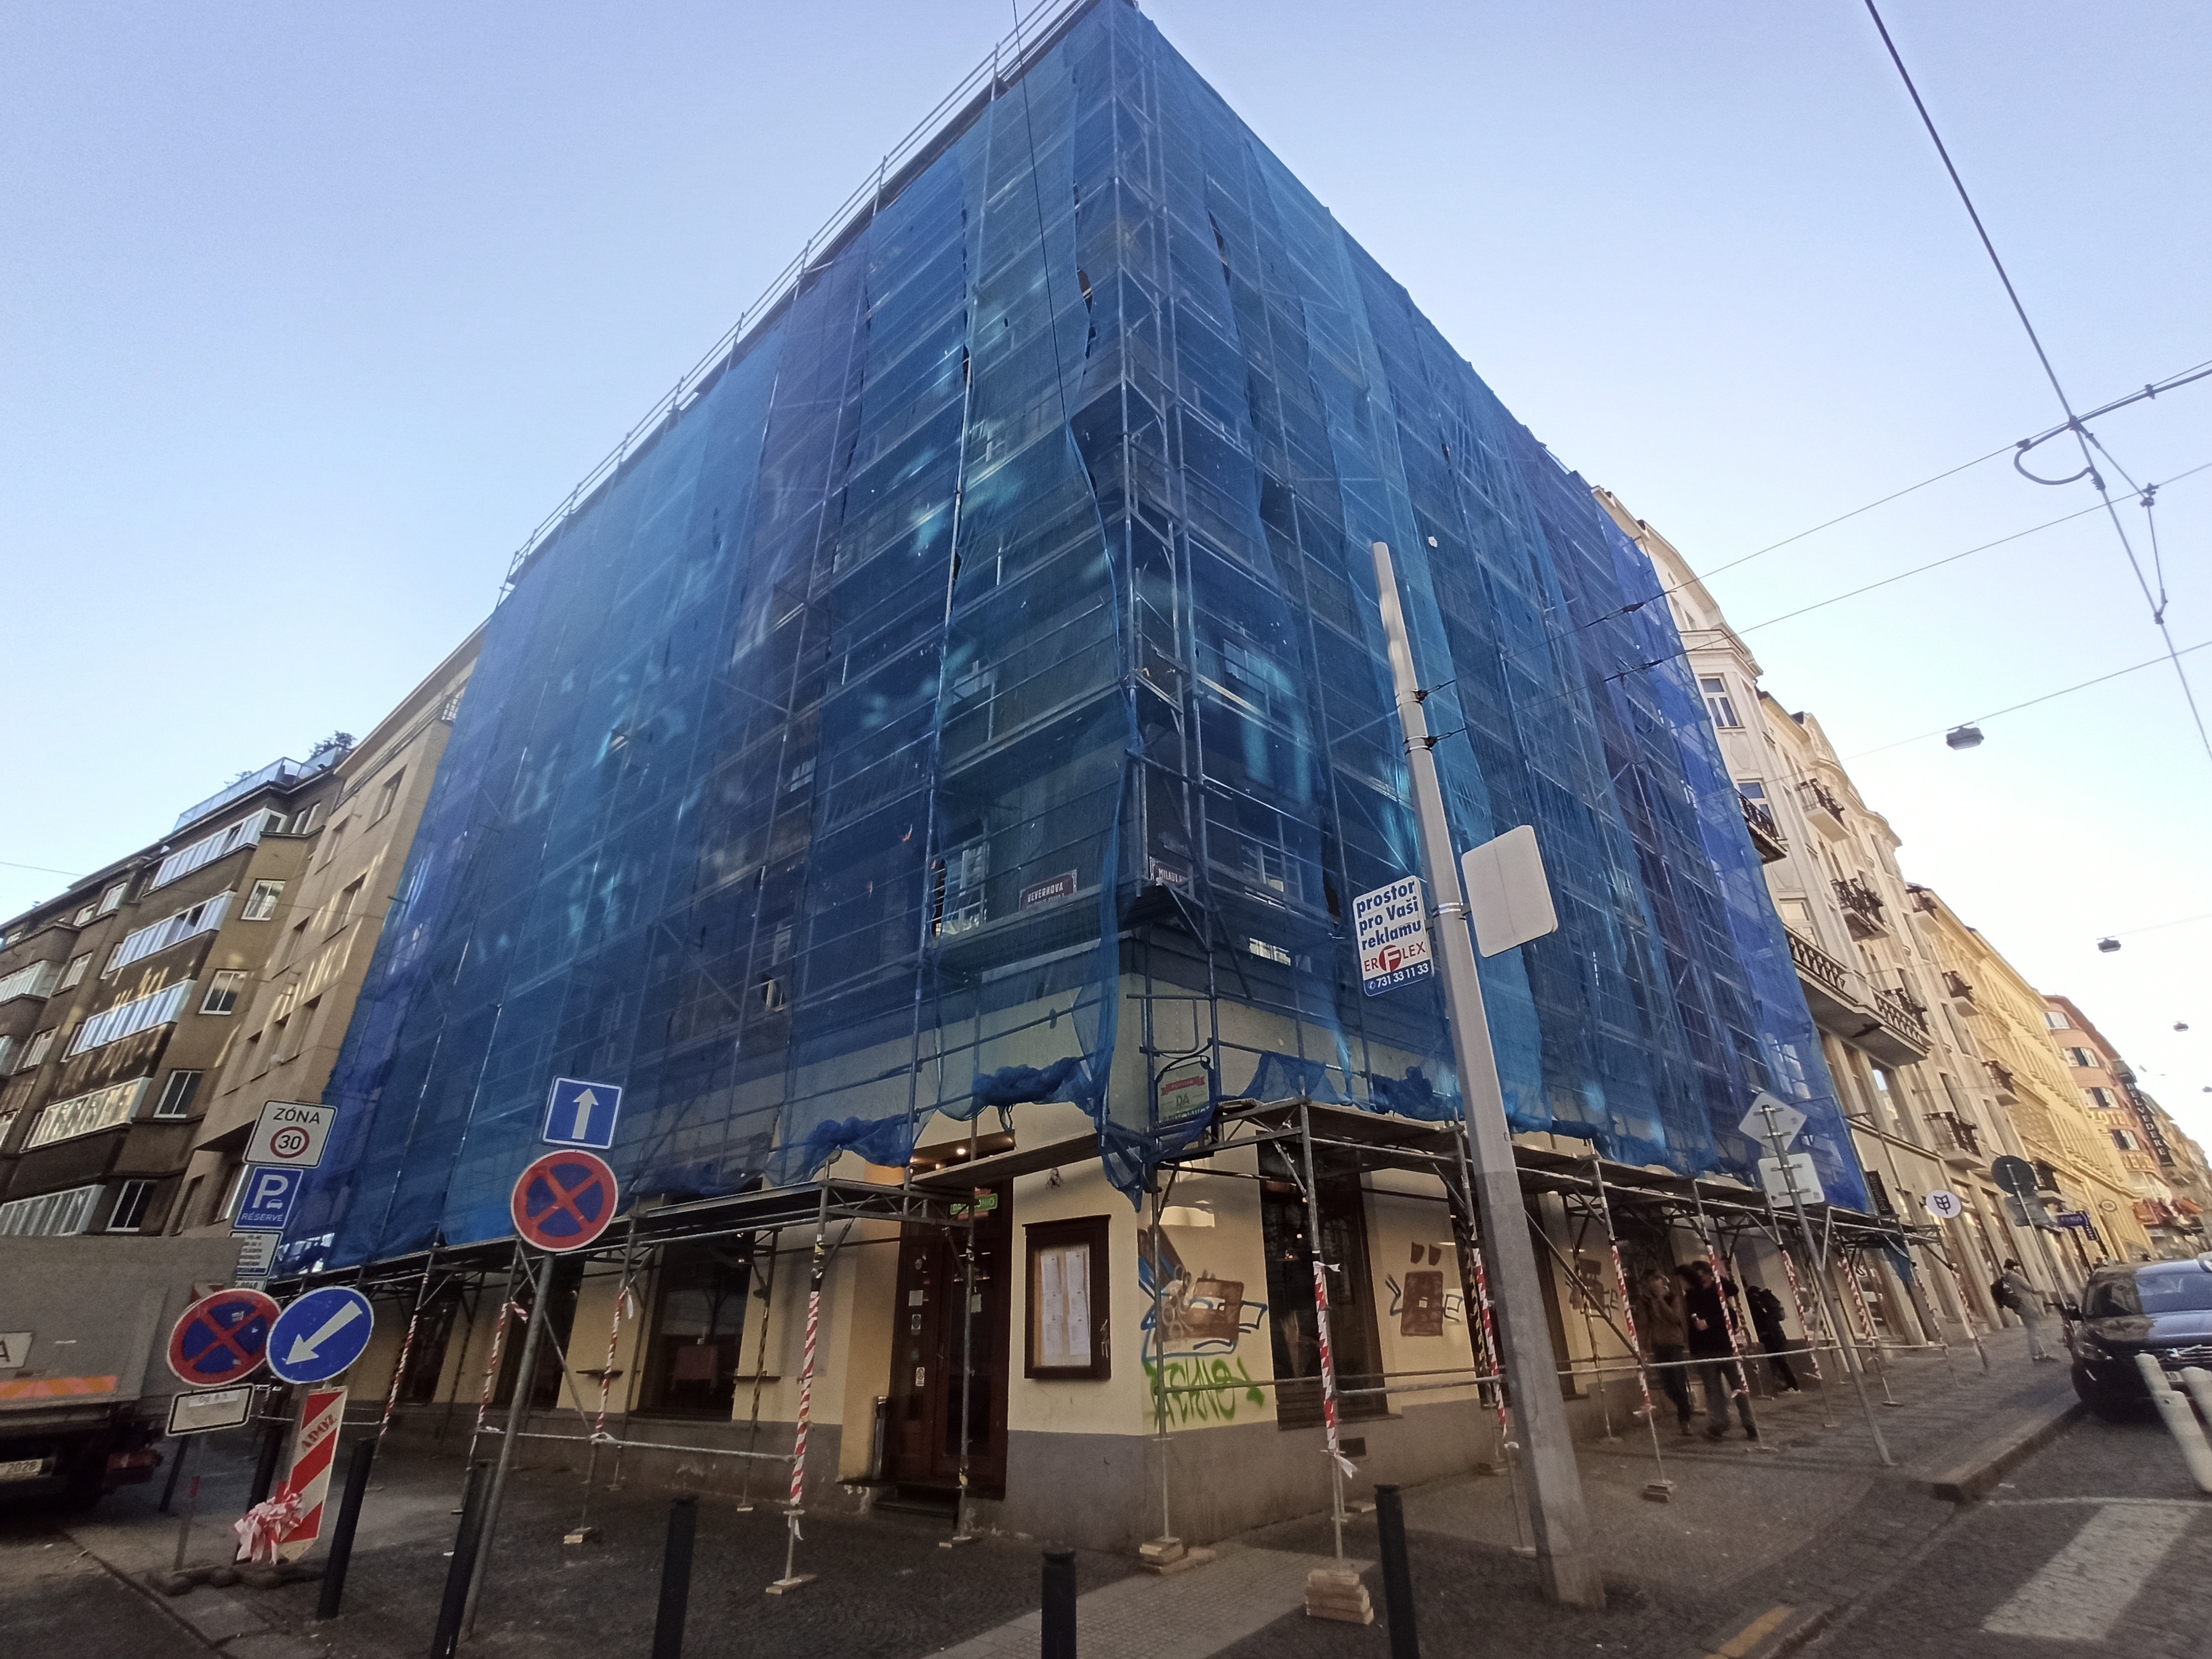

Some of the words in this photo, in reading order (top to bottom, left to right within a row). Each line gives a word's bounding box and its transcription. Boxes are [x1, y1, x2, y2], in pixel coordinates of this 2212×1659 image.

[1027, 882, 1063, 903] VEVERKOVA
[1356, 880, 1415, 919] prostor
[1359, 914, 1383, 937] pro
[1385, 895, 1419, 921] Vaši
[1361, 920, 1422, 951] reklamu
[1376, 976, 1392, 989] 731
[1393, 970, 1405, 983] 33
[1406, 967, 1416, 978] 11
[1417, 962, 1429, 975] 33
[273, 1106, 320, 1124] ZÓNA
[1176, 1093, 1190, 1106] DA
[2126, 1082, 2167, 1155] BELVEDERE
[278, 1134, 302, 1150] 30
[251, 1174, 289, 1209] P
[1869, 1175, 1889, 1211] papelote
[301, 1413, 337, 1452] ADOZ
[6, 1460, 37, 1474] 2028
